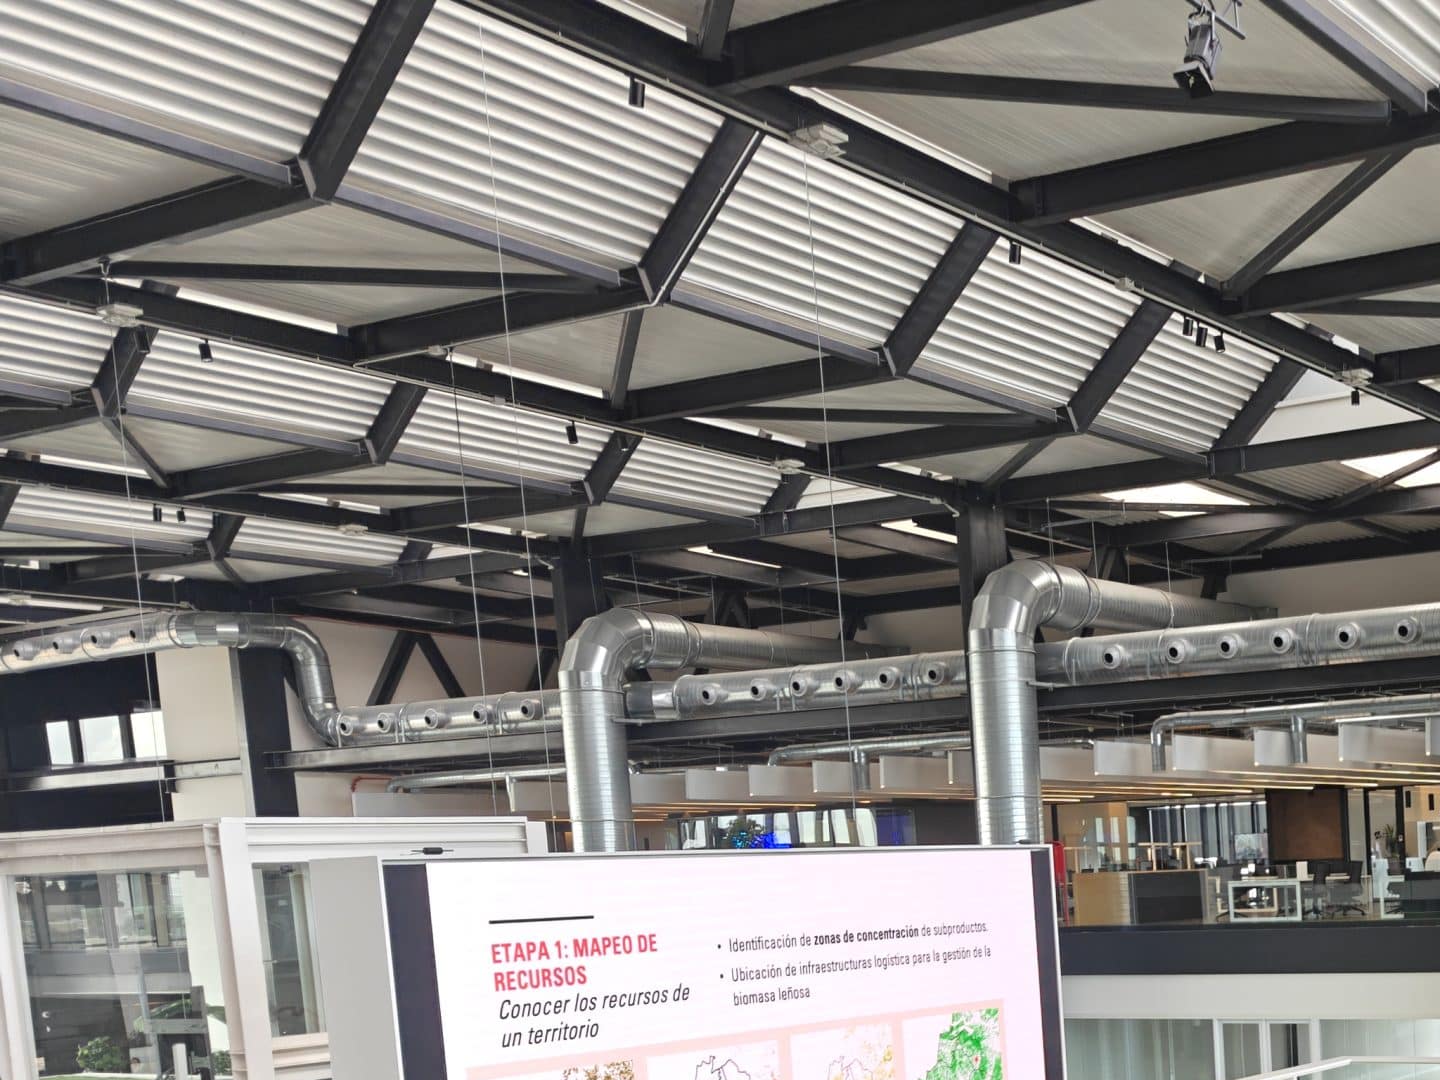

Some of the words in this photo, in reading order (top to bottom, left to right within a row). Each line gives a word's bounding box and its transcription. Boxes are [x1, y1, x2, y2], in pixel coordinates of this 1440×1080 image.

[491, 940, 550, 964] ETAPA
[554, 940, 569, 959] 1:
[572, 935, 633, 958] MAPEO
[637, 934, 657, 953] DE
[728, 933, 798, 952] Identificación
[800, 932, 811, 946] de
[814, 933, 841, 945] zonas
[843, 929, 855, 943] de
[857, 924, 919, 942] concentración
[921, 924, 931, 937] de
[494, 965, 588, 991] RECURSOS
[731, 963, 782, 982] Ubicación
[785, 962, 797, 976] de
[799, 957, 873, 976] infraestructuras
[912, 953, 931, 965] para
[933, 948, 940, 961] la
[942, 947, 971, 964] gestión
[973, 946, 983, 958] de
[984, 945, 991, 957] la
[499, 998, 570, 1020] Conocer
[574, 993, 597, 1012] los
[602, 988, 668, 1009] recursos
[672, 983, 690, 1002] de
[733, 991, 776, 1006] biomasa
[778, 986, 811, 1001] leñosa
[501, 1030, 522, 1048] un
[528, 1019, 599, 1045] territorio
